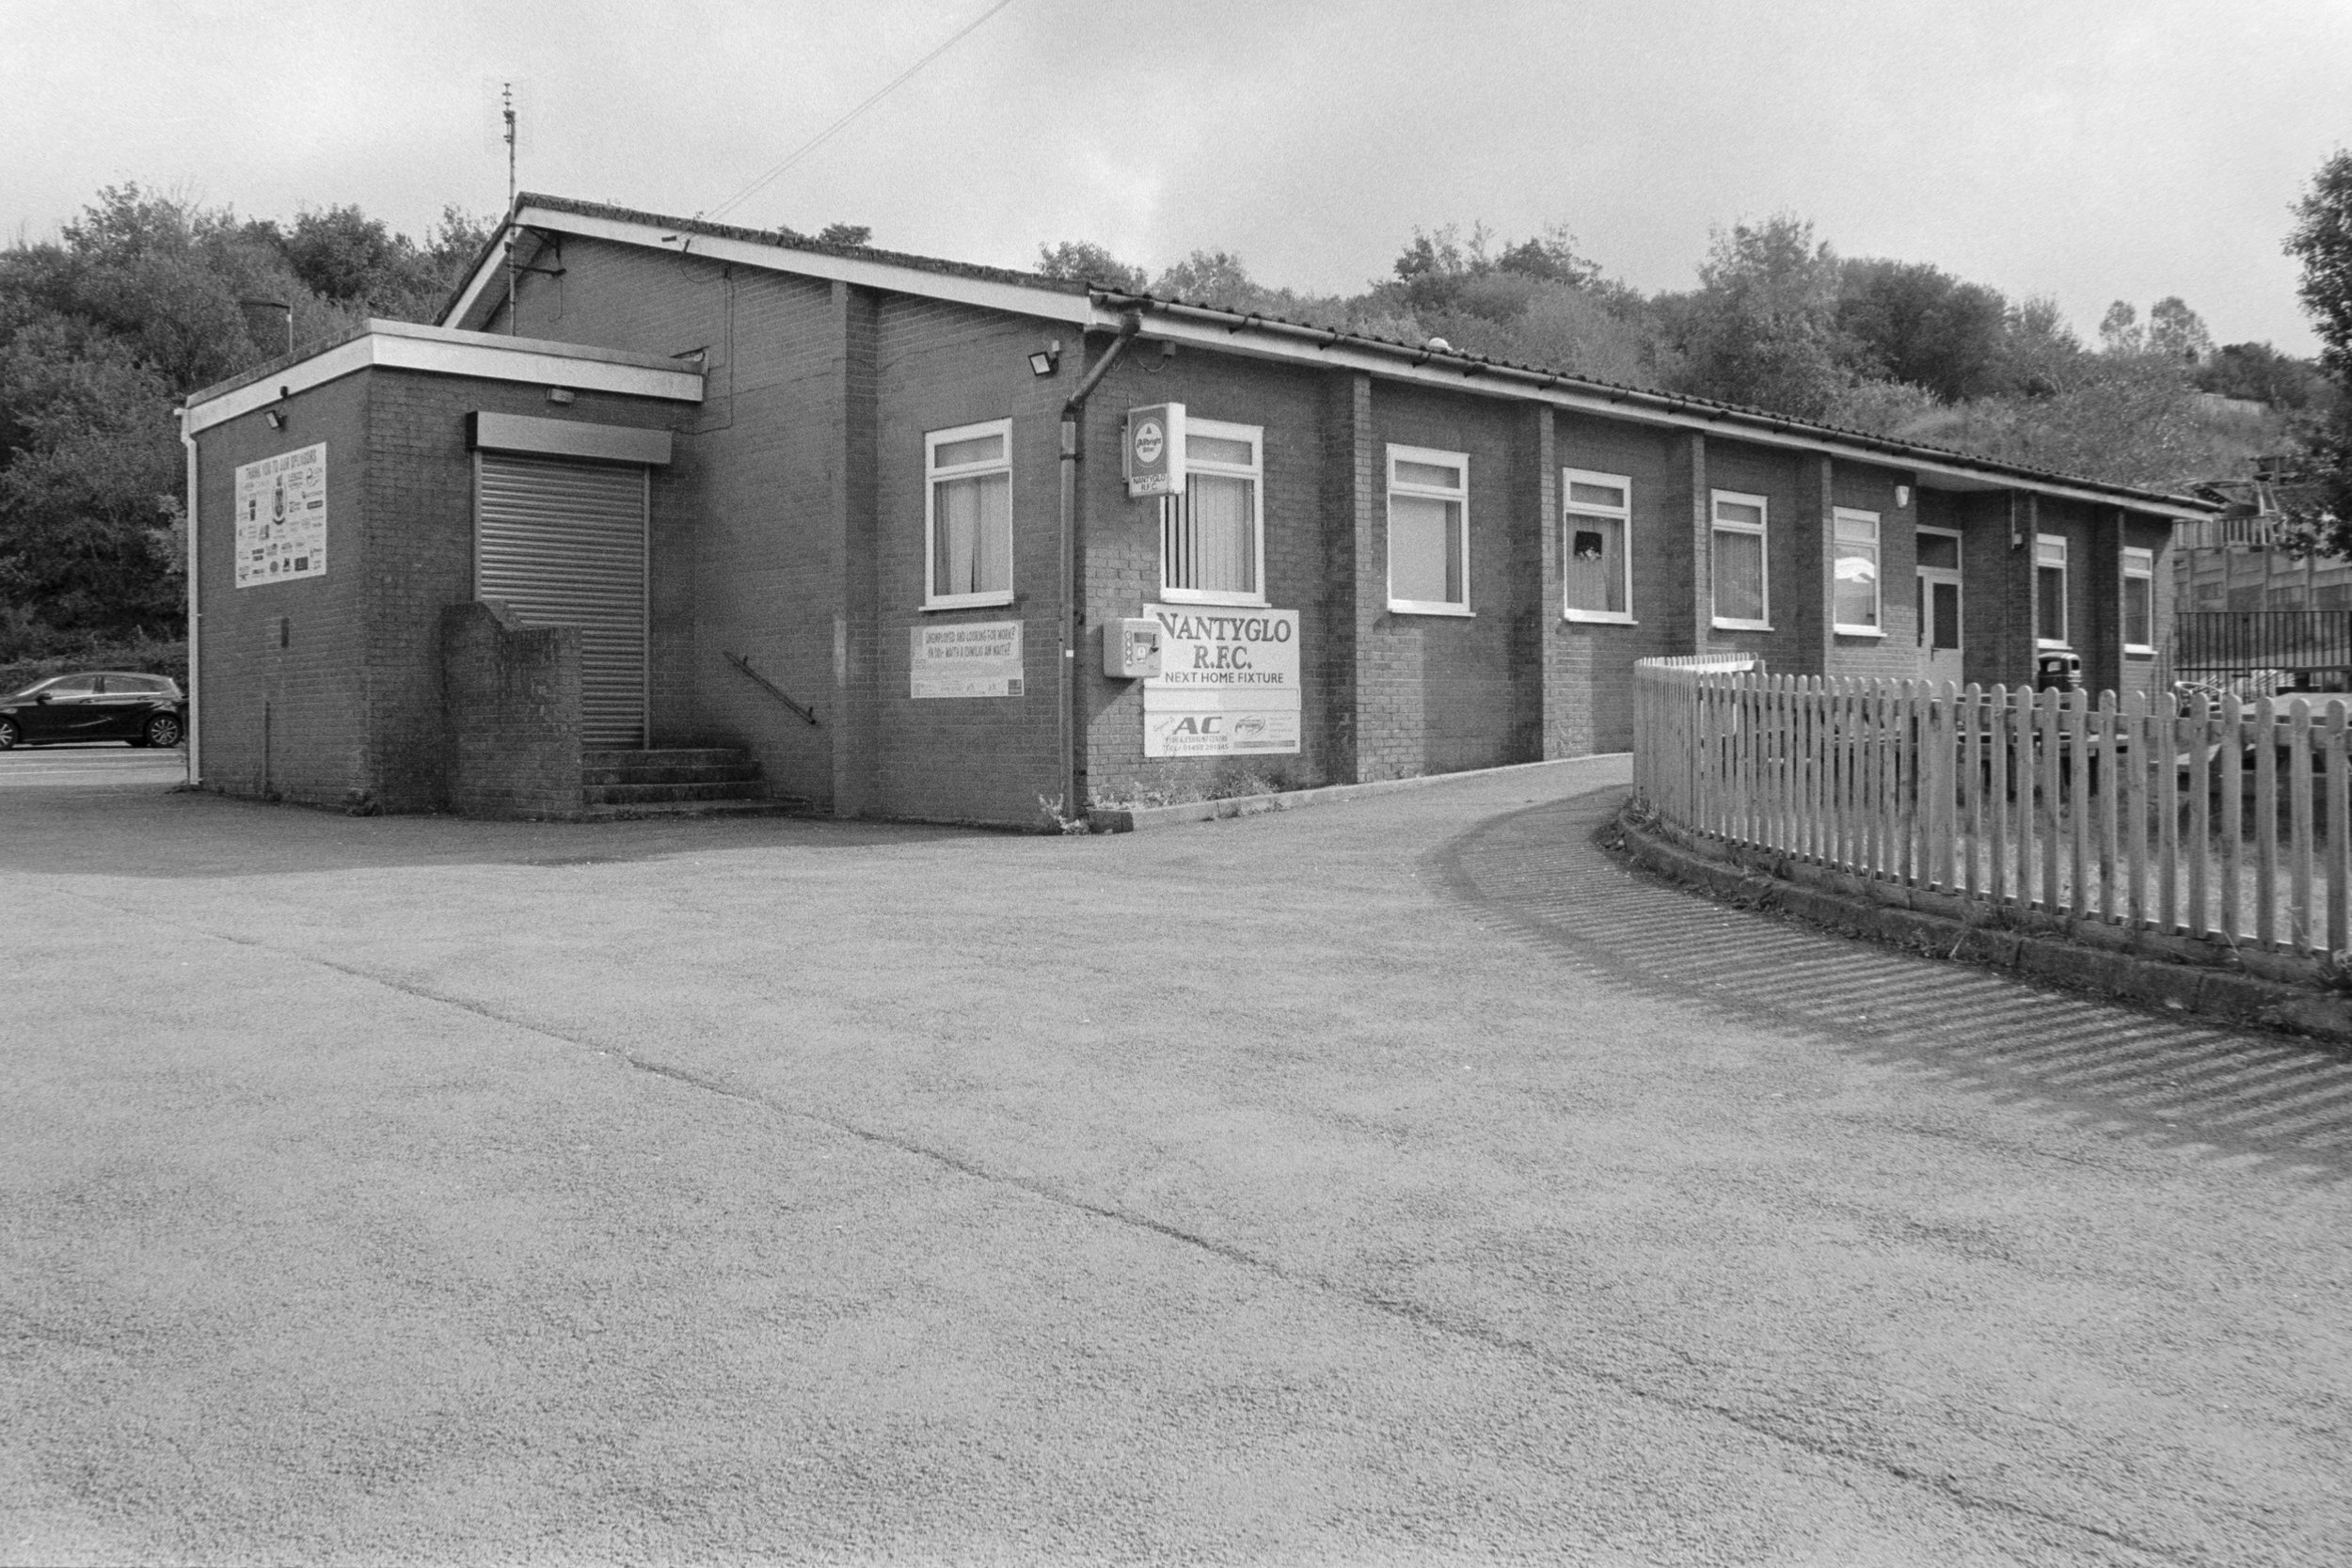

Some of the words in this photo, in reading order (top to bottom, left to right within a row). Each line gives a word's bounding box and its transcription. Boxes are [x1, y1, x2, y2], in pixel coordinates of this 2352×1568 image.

[1133, 474, 1166, 484] NANTYGLO
[1155, 611, 1292, 642] NANTYGLO
[1193, 644, 1253, 670] R.F.C.
[1165, 672, 1198, 684] NEXT
[1200, 672, 1235, 684] HOME
[1237, 673, 1284, 684] FIXTURE
[1172, 716, 1222, 735] AC
